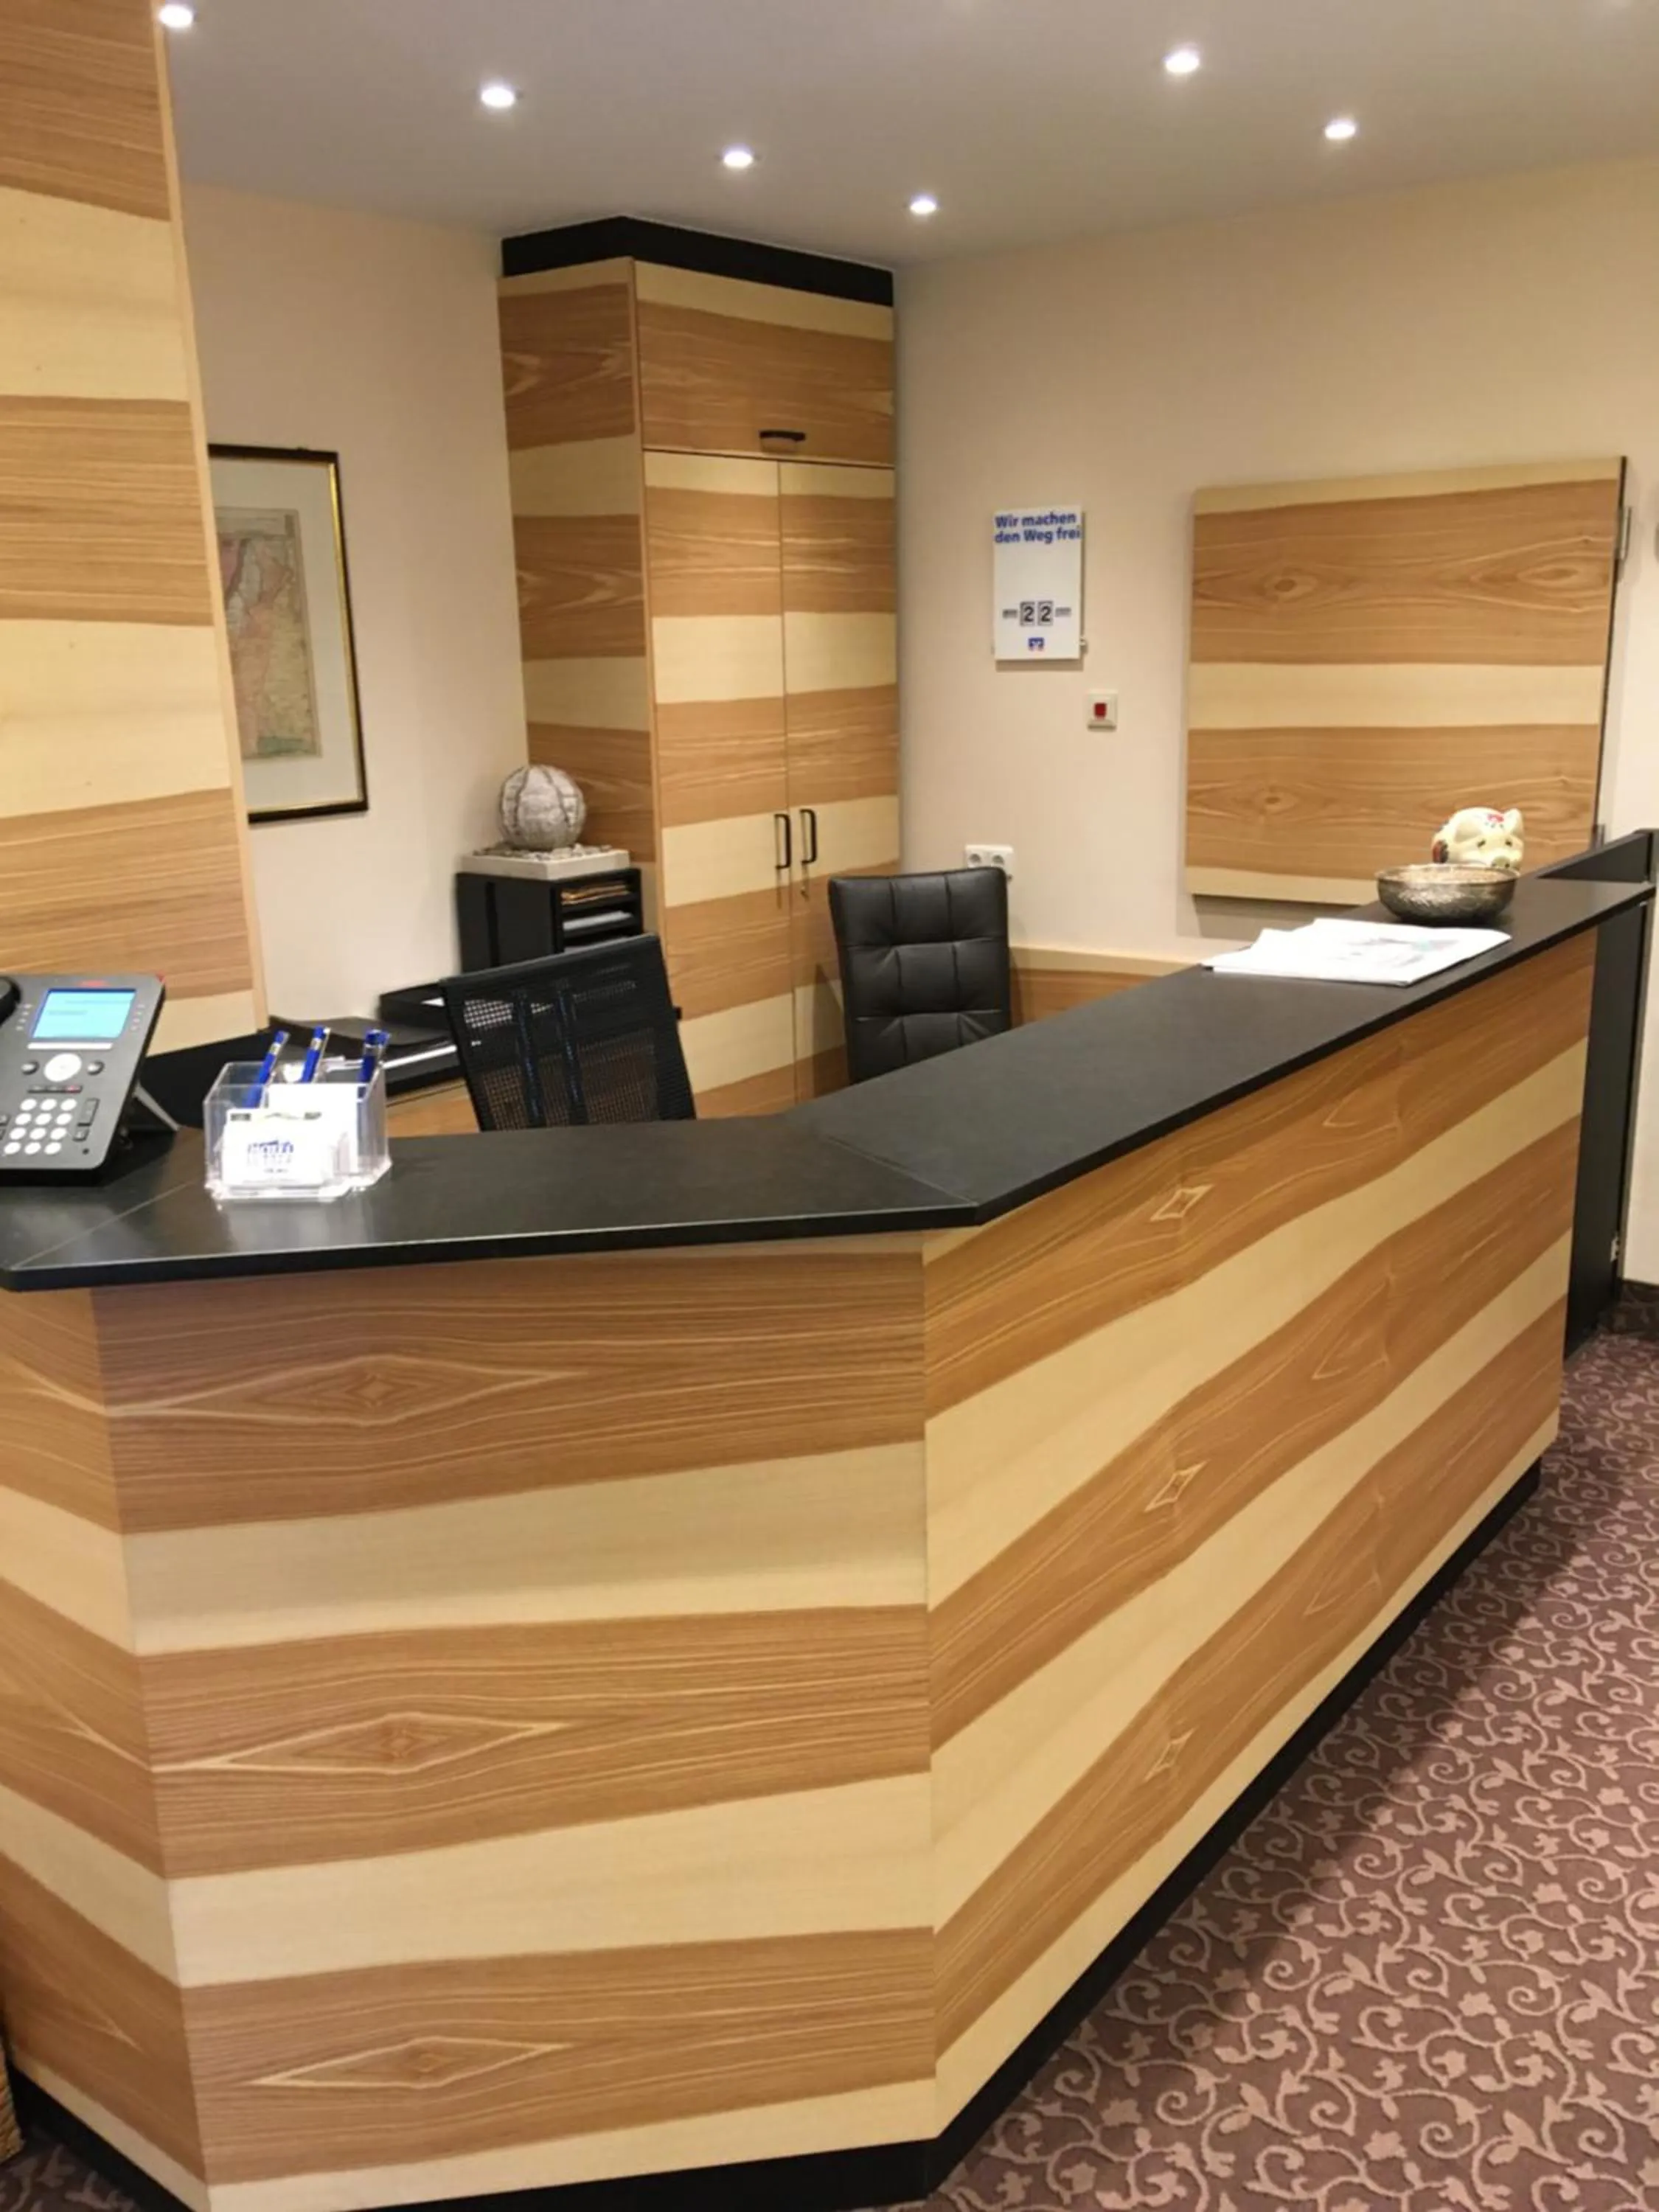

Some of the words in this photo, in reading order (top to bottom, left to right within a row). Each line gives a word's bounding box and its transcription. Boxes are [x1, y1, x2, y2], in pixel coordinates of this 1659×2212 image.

[995, 514, 1018, 529] Wir
[1021, 511, 1077, 526] machen
[994, 530, 1020, 543] den
[1023, 529, 1054, 545] Weg
[1056, 526, 1081, 540] frei
